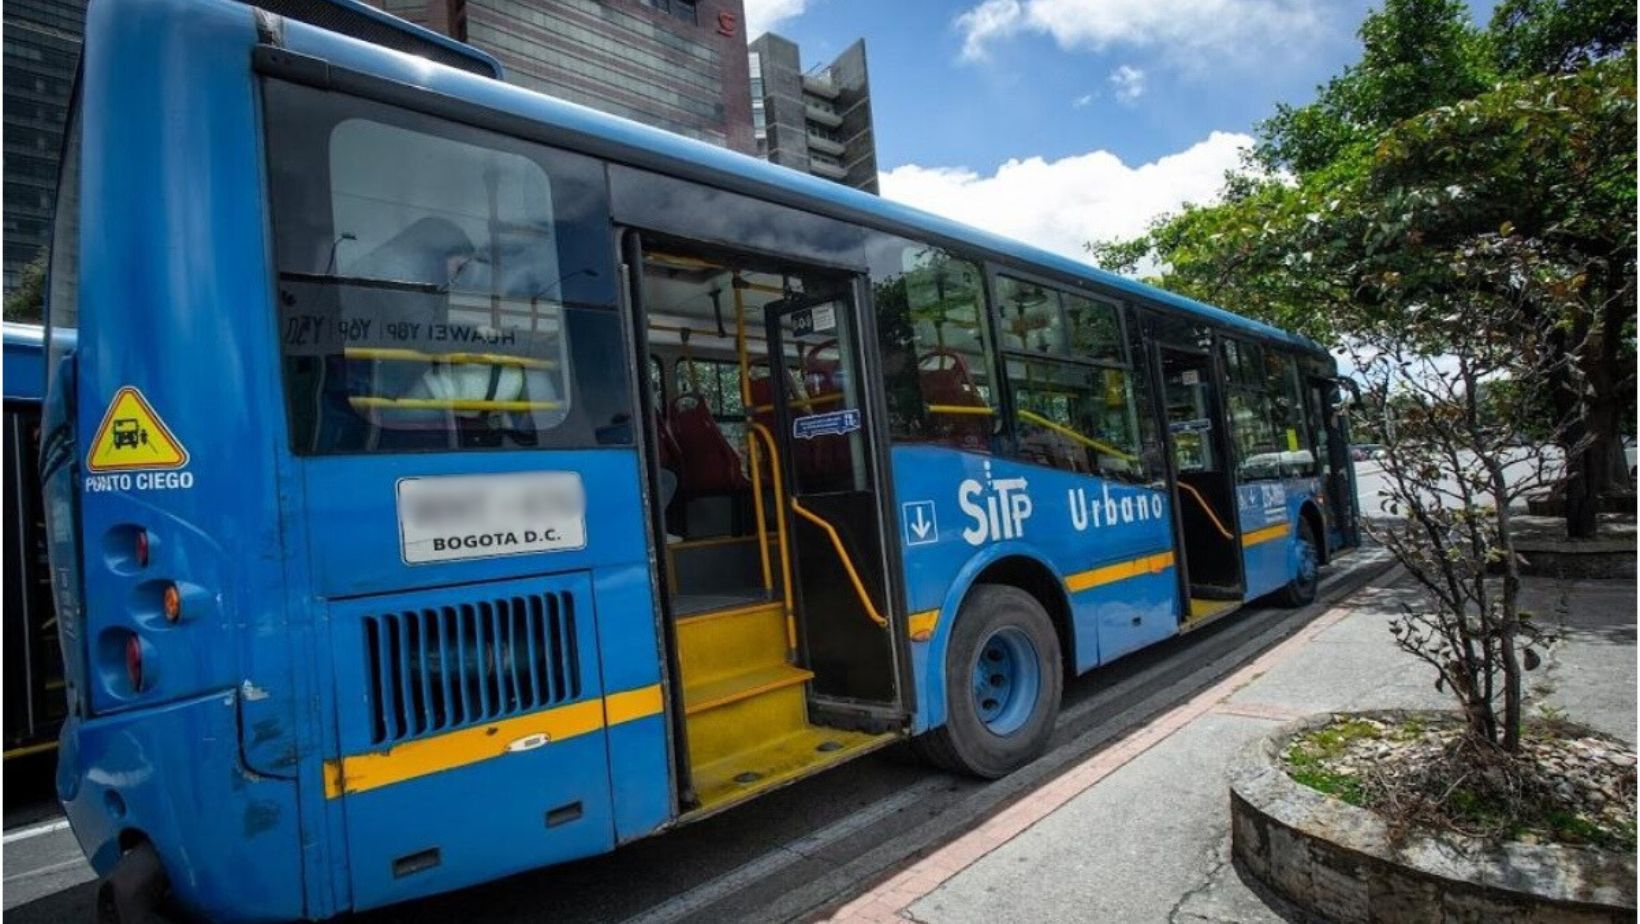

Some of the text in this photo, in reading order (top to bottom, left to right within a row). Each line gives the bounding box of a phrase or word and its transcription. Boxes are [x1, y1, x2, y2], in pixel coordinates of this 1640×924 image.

[86, 472, 193, 492] PUNTO CIEGO
[1068, 483, 1163, 531] Urbano
[433, 528, 561, 551] BOGOTA D.C.
